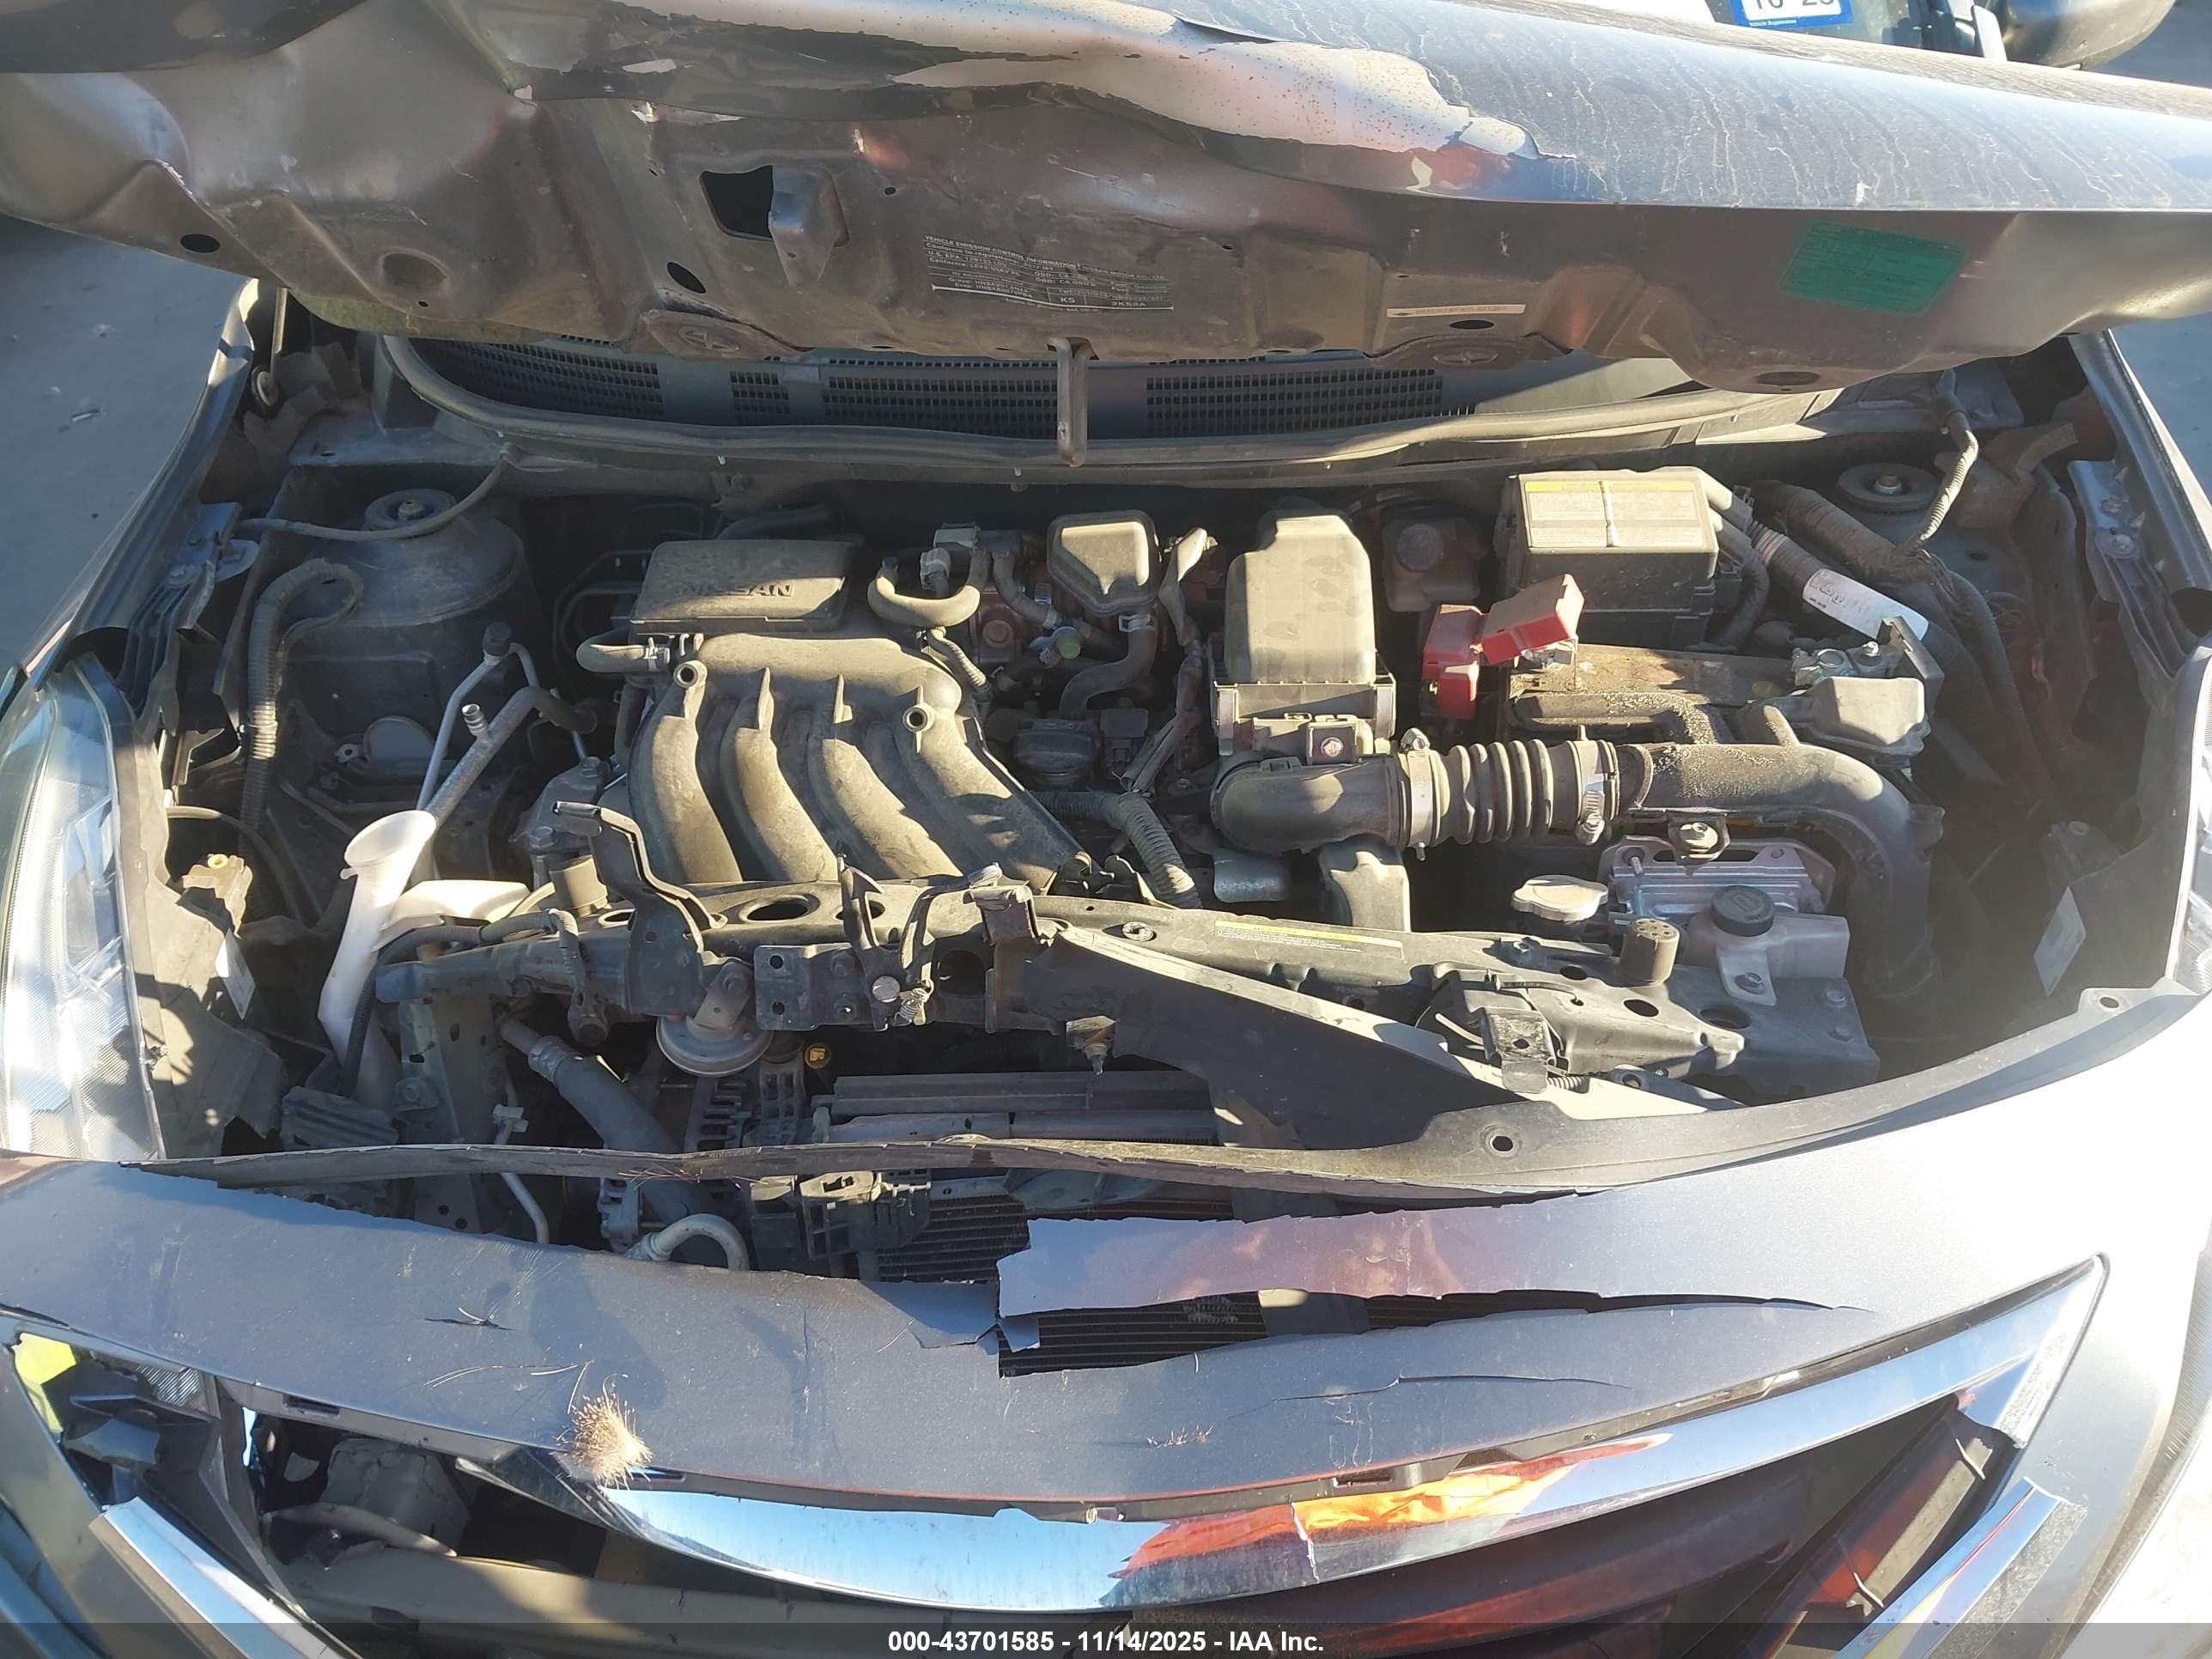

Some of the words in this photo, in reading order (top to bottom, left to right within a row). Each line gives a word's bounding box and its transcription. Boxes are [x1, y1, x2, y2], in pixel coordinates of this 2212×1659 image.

[923, 234, 955, 245] VEHICLE
[955, 241, 991, 252] EMISSION
[992, 247, 1024, 260] CONTROL
[1026, 256, 1077, 269] INFORMATION
[927, 242, 963, 253] Conforms
